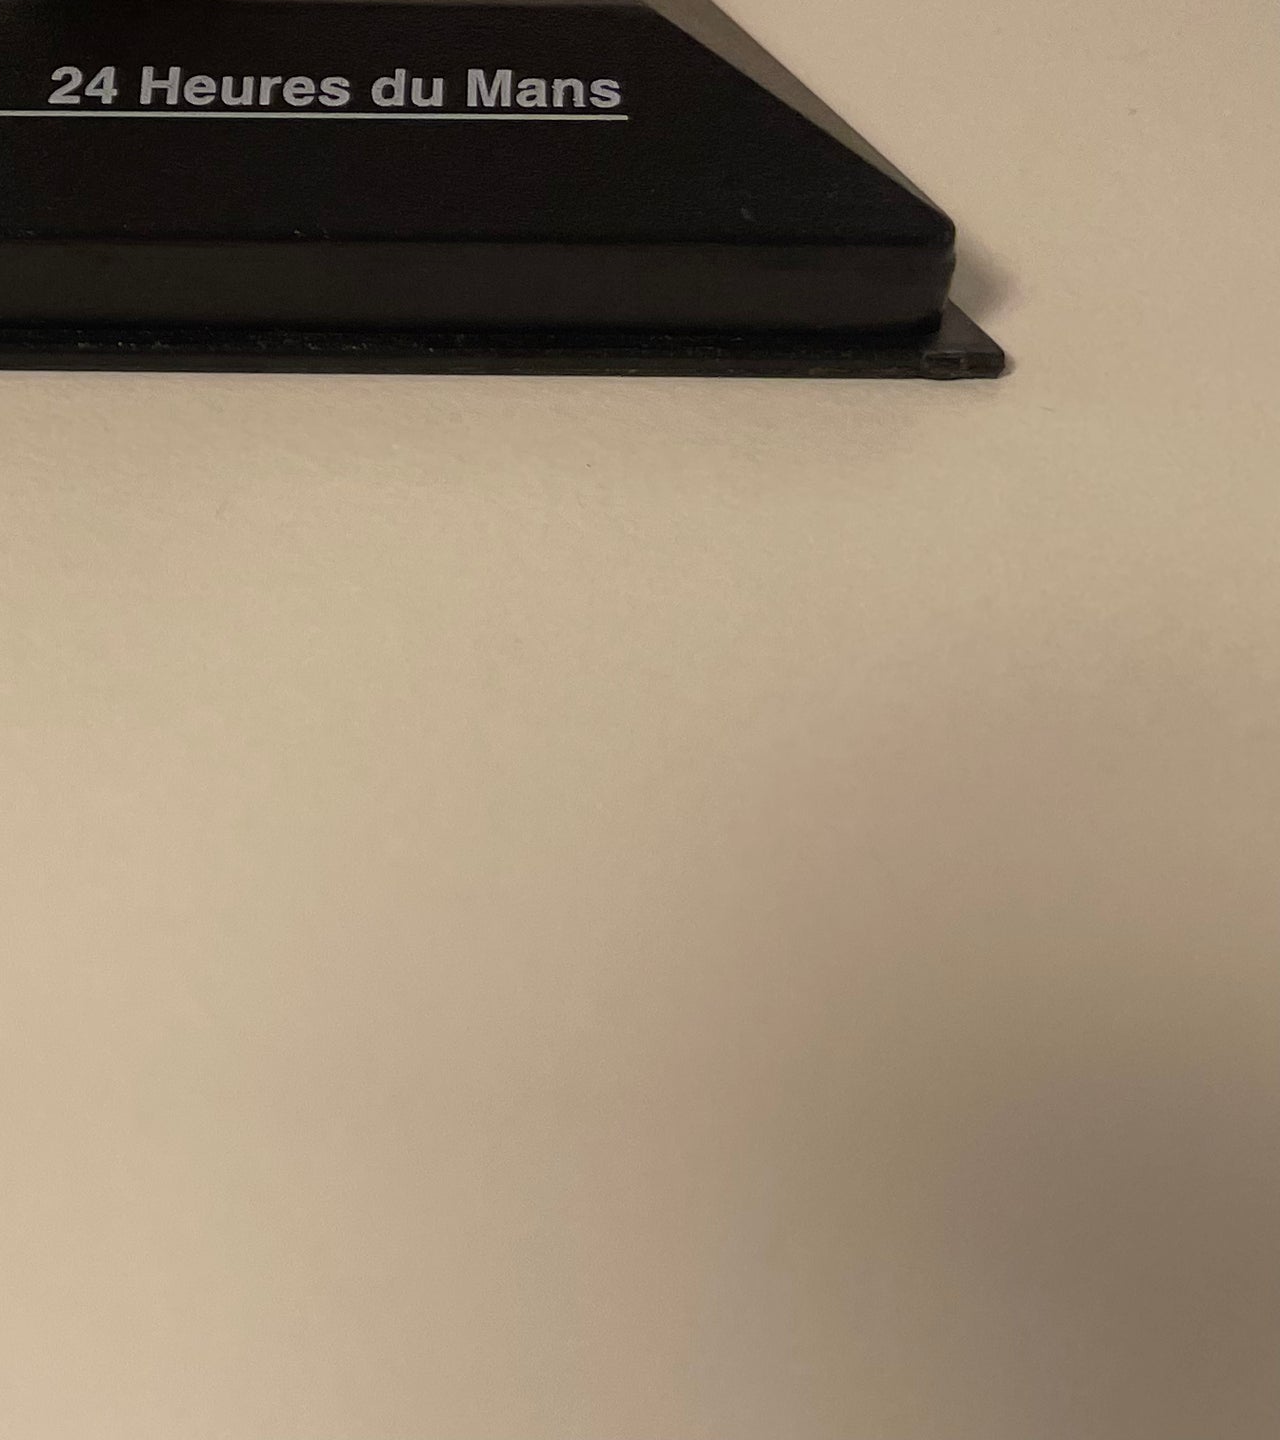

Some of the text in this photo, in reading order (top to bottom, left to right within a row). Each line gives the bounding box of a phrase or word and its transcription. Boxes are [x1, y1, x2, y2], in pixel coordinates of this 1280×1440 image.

[47, 66, 621, 108] 24 Heures du Mans
